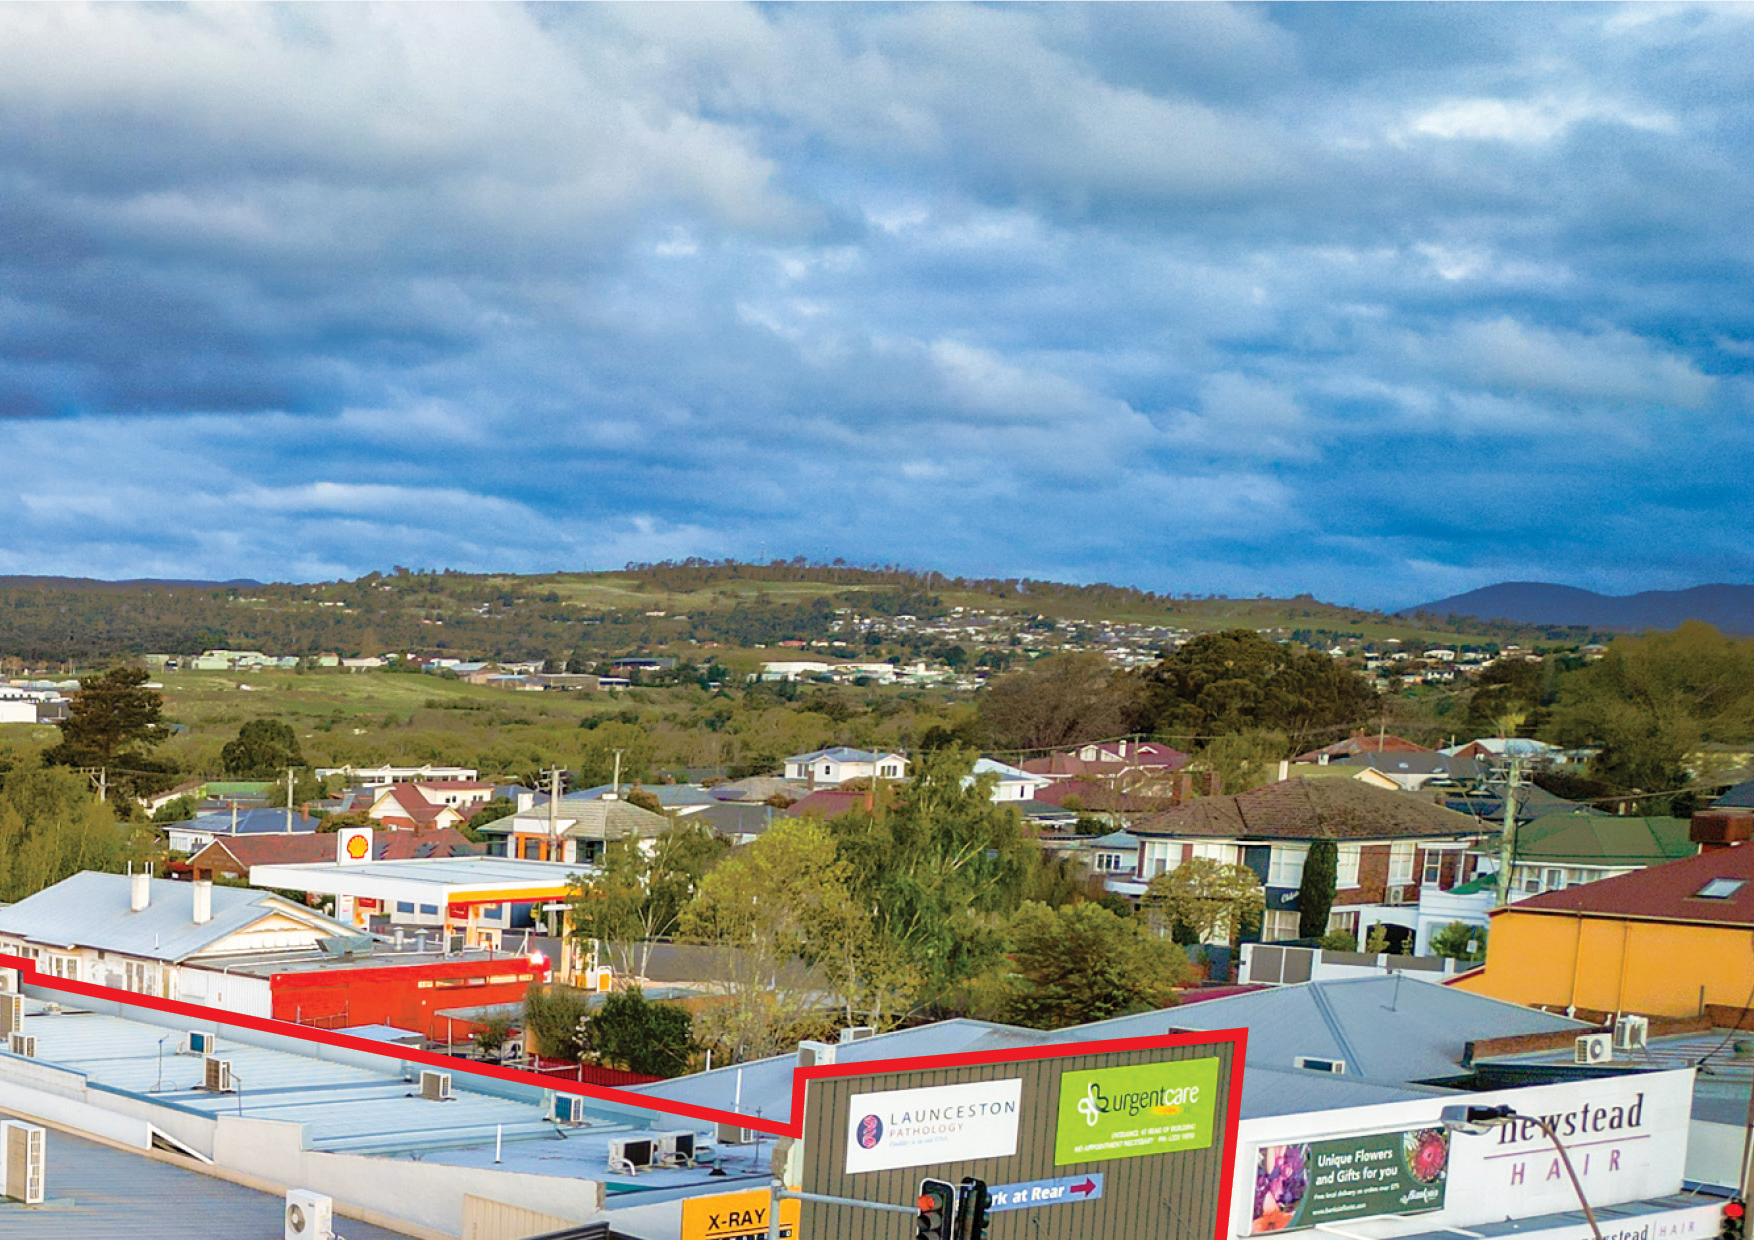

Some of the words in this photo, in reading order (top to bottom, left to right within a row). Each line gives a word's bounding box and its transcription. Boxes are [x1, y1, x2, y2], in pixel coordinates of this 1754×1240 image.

[1113, 1086, 1199, 1116] urgentcare
[890, 1100, 1015, 1125] LAUNCESTON
[1497, 1092, 1644, 1144] newstead
[889, 1123, 964, 1137] PATHOLOGY
[1318, 1153, 1352, 1168] Unique
[1354, 1148, 1393, 1163] Flowers
[1510, 1149, 1620, 1186] HAIR
[1315, 1171, 1334, 1186] and
[1336, 1168, 1361, 1183] Gifts
[1363, 1166, 1378, 1179] for
[1379, 1167, 1398, 1180] you
[991, 1191, 1008, 1206] rk
[1012, 1189, 1028, 1204] at
[1031, 1186, 1066, 1201] Rear
[708, 1208, 766, 1231] X-RAY
[1659, 1221, 1695, 1237] HAIR
